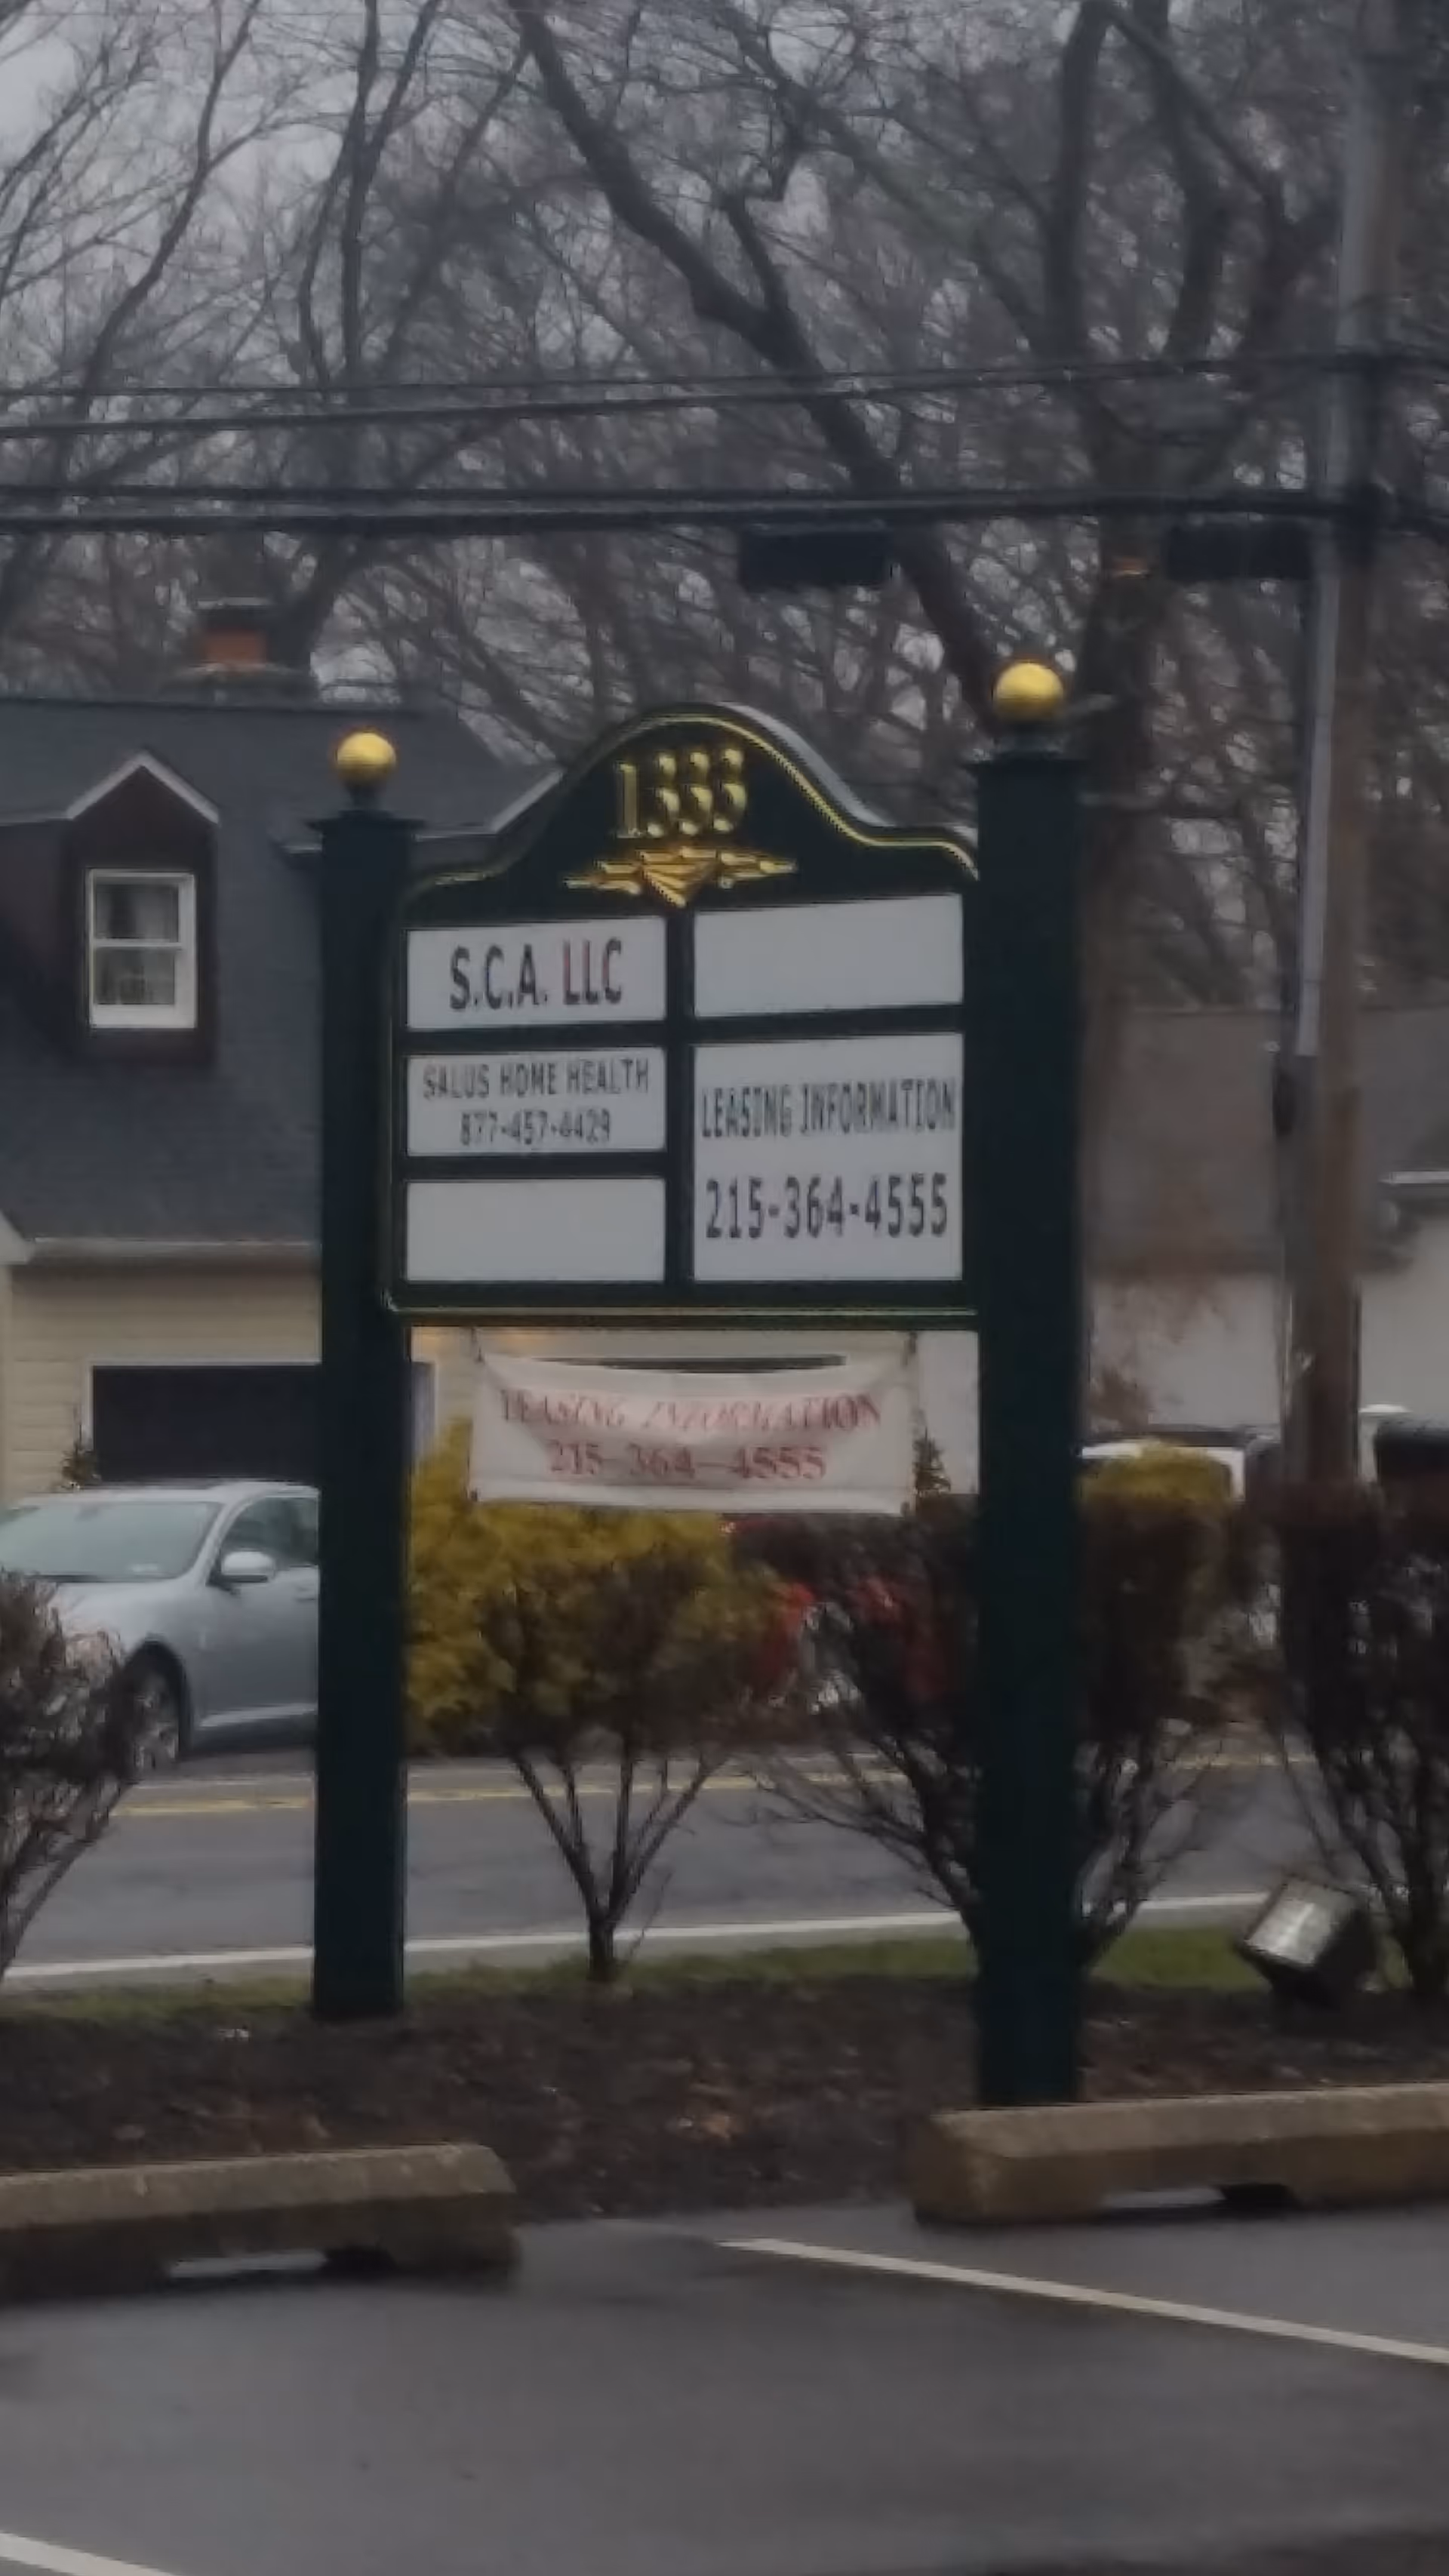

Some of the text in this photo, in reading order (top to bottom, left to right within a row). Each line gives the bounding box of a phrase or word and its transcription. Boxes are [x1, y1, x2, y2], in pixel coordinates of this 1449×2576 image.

[617, 747, 746, 839] 1333
[450, 936, 622, 1010] S.C.A. LLC
[423, 1057, 649, 1100] SALUS HOME HEALTH
[702, 1078, 957, 1137] LEASING INFORMATION
[706, 1172, 947, 1239] 215-364-4555
